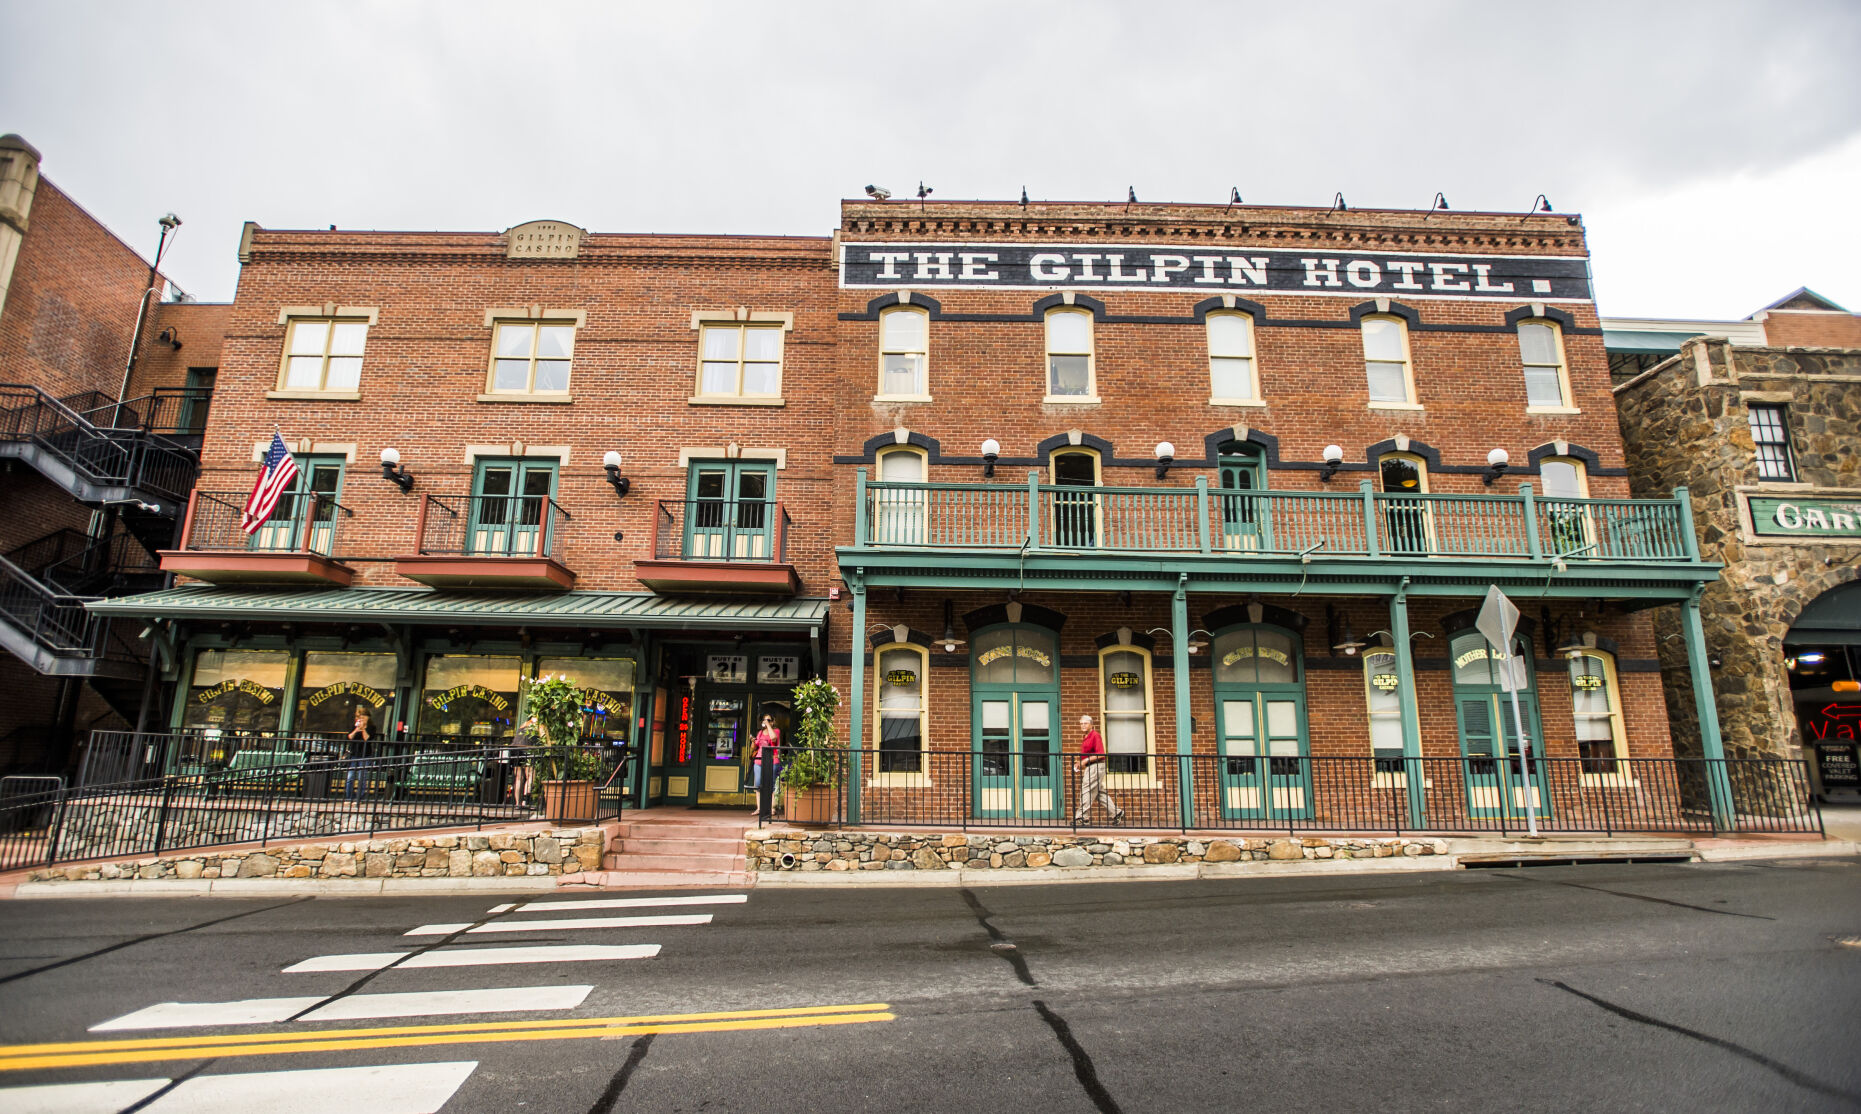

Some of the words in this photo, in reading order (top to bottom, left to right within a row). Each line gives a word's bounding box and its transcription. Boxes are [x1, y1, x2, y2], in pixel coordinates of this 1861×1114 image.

[515, 245, 573, 253] CASINO
[517, 233, 574, 242] GILPIN
[869, 252, 999, 280] THE
[1030, 253, 1269, 285] GILPIN
[1776, 503, 1861, 530] GAR
[716, 662, 737, 678] 21
[767, 663, 788, 679] 21
[1455, 648, 1488, 669] MOTHER
[198, 678, 237, 704] GILPIN
[240, 678, 275, 705] CASINO
[308, 681, 347, 707] GILPIN
[349, 681, 386, 709] CASINO
[1575, 679, 1602, 687] GILPIN
[431, 684, 469, 710] GILPIN
[472, 684, 509, 711] CASINO
[585, 687, 622, 714] CASINO
[681, 696, 689, 721] OPEN
[678, 731, 687, 762] HOURS
[720, 740, 730, 748] 21
